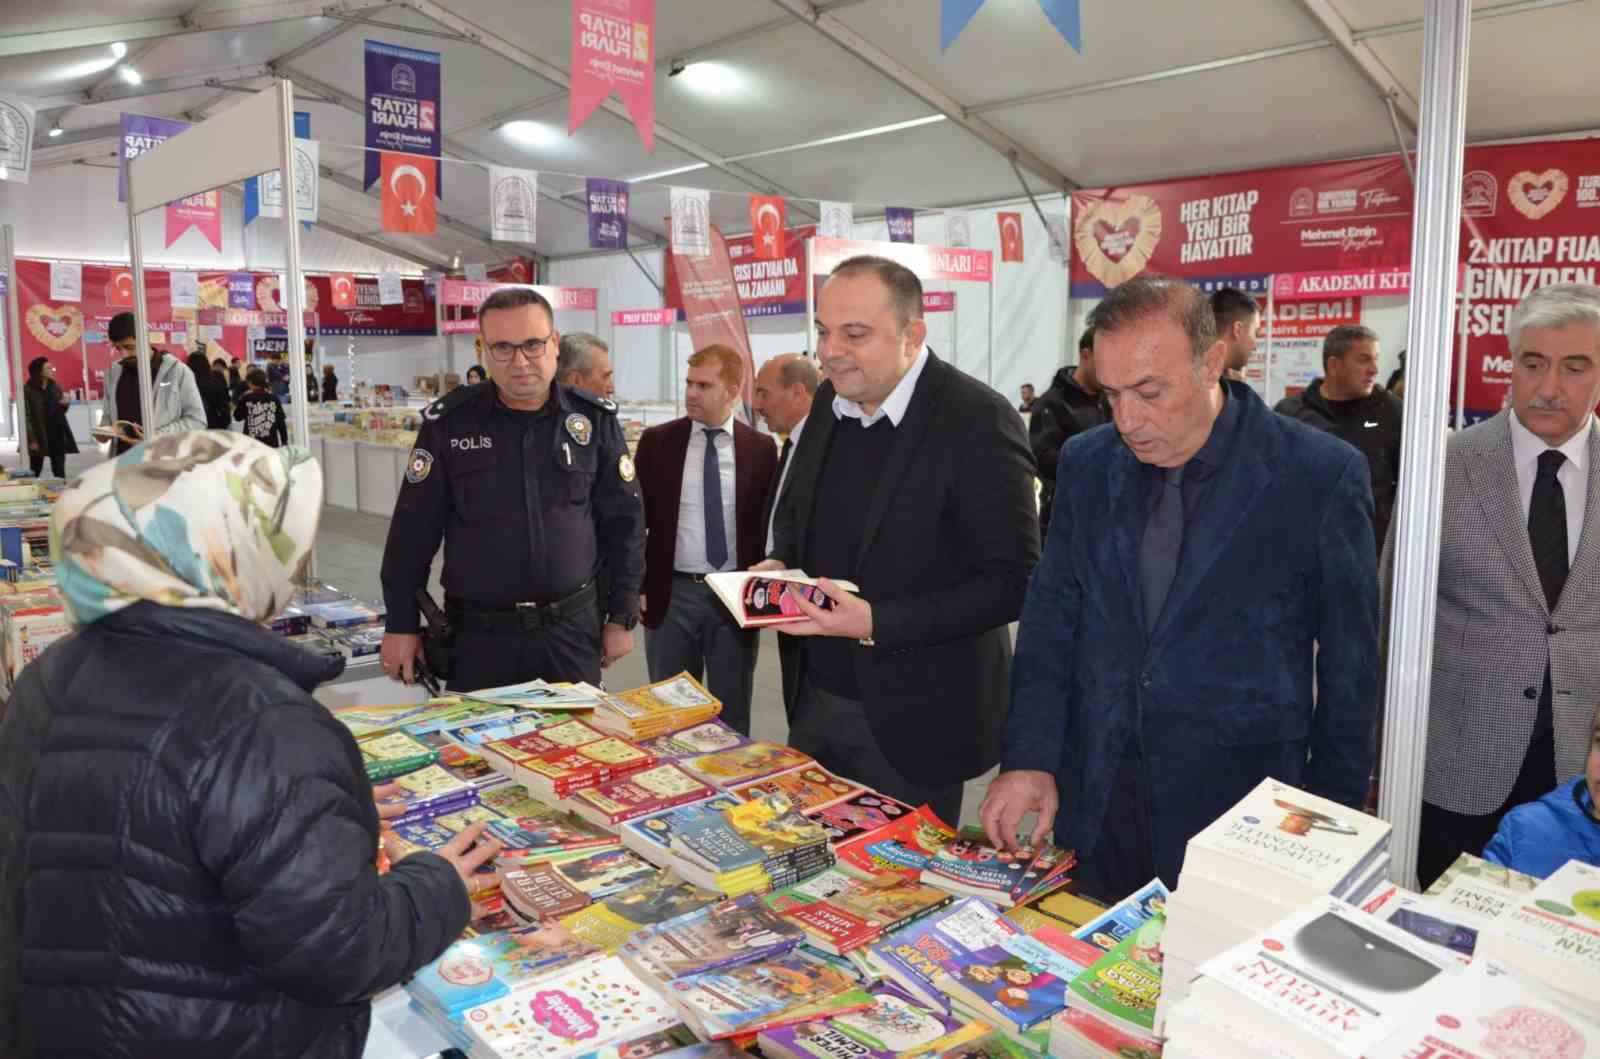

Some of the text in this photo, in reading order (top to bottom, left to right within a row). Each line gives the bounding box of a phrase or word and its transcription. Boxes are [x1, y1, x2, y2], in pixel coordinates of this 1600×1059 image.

[1180, 199, 1211, 224] HER
[1186, 213, 1250, 241] YENİ BİR
[1300, 228, 1346, 241] Mehmet
[1180, 234, 1253, 264] HAYATTIR
[1555, 235, 1600, 262] FUA
[1298, 269, 1376, 293] AKADEMİ
[451, 434, 493, 450] POLİS
[828, 1029, 868, 1055] CEMİL
